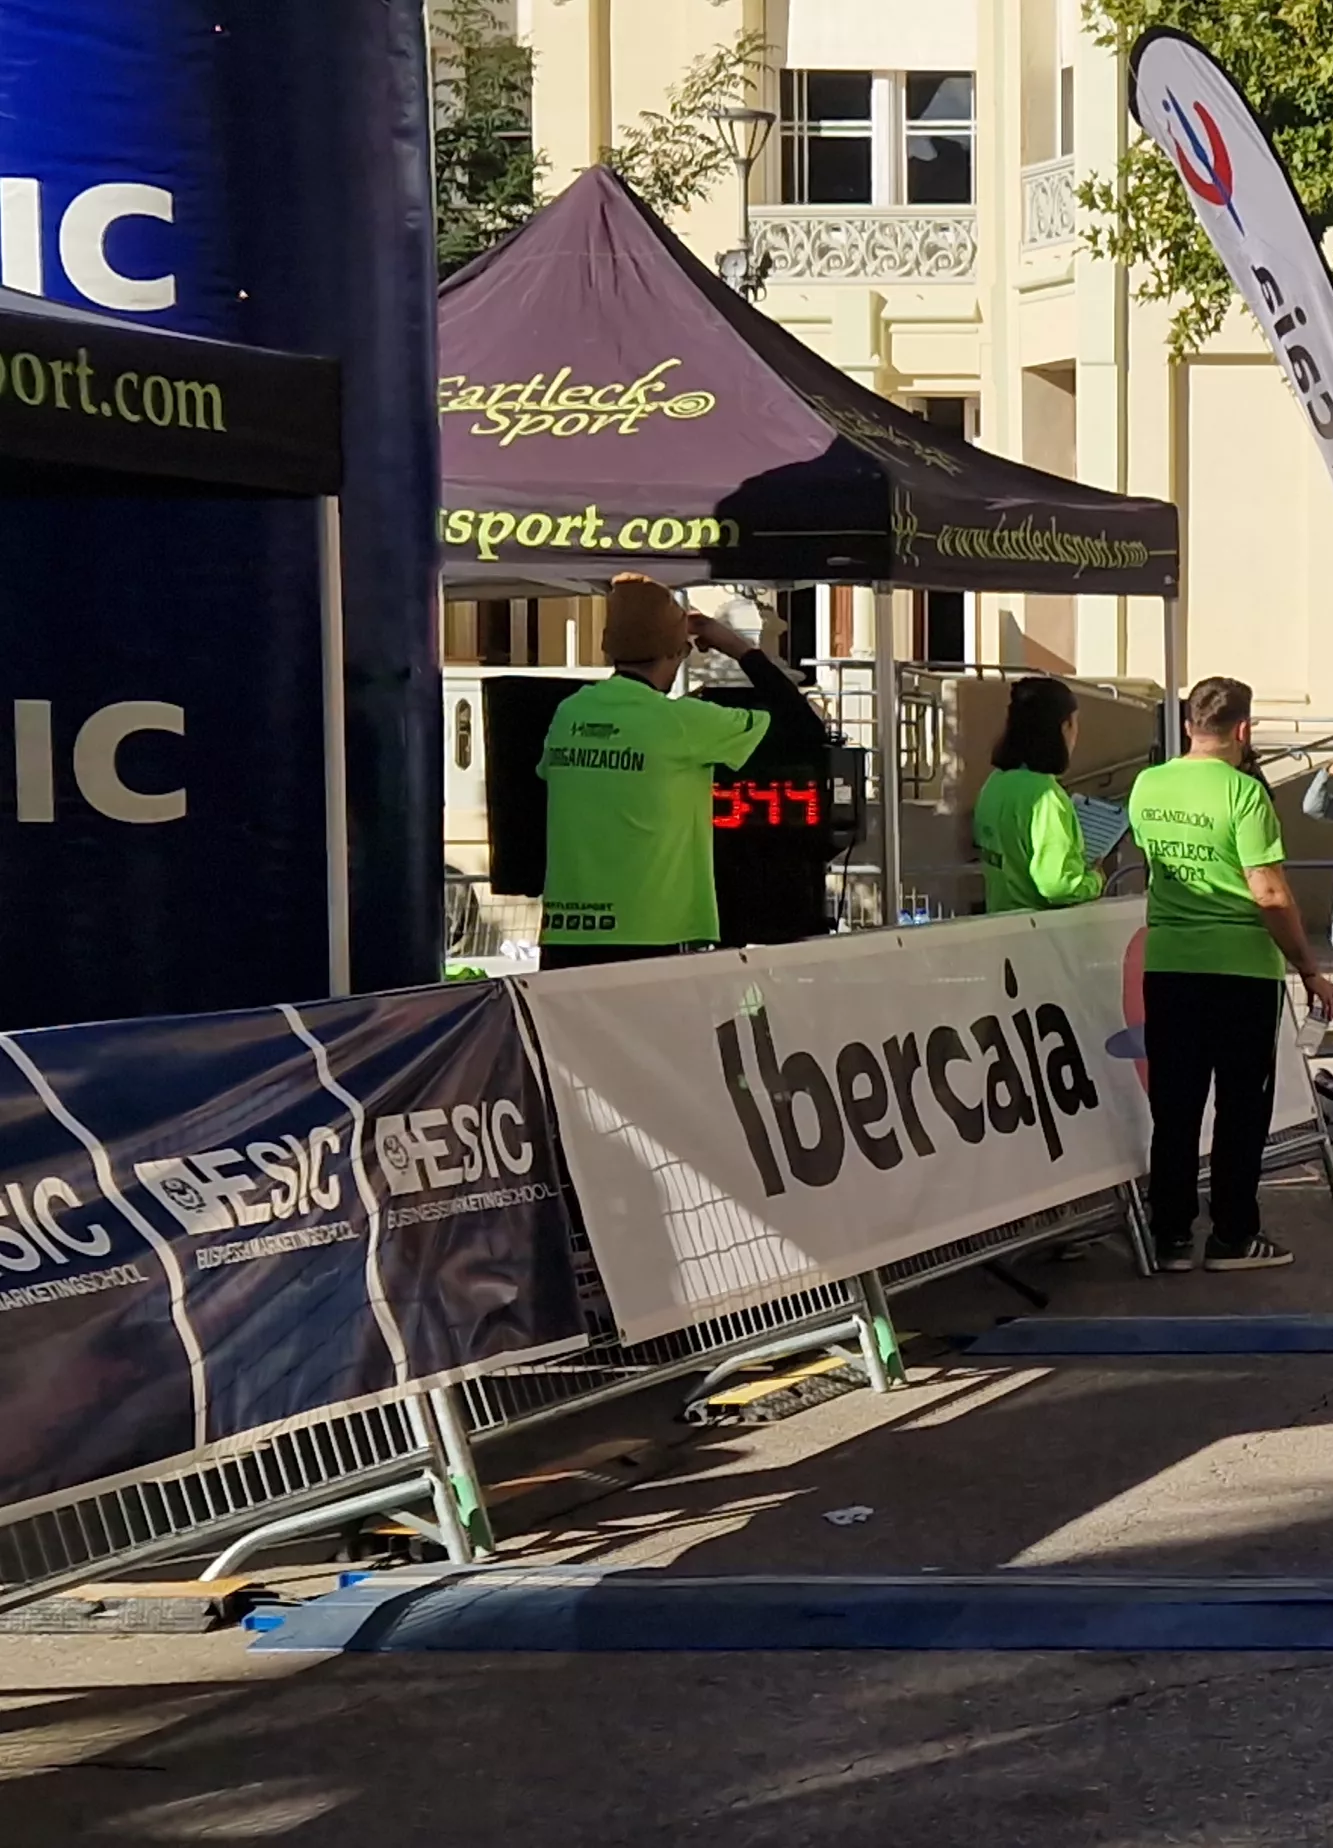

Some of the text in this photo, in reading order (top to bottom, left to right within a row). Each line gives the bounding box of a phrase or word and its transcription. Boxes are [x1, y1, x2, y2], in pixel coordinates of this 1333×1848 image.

[0, 347, 228, 432] ort.com
[471, 402, 650, 447] Sport
[716, 958, 1099, 1198] Ibercaja
[190, 1126, 341, 1228] ESIC
[400, 1099, 533, 1188] ESIC
